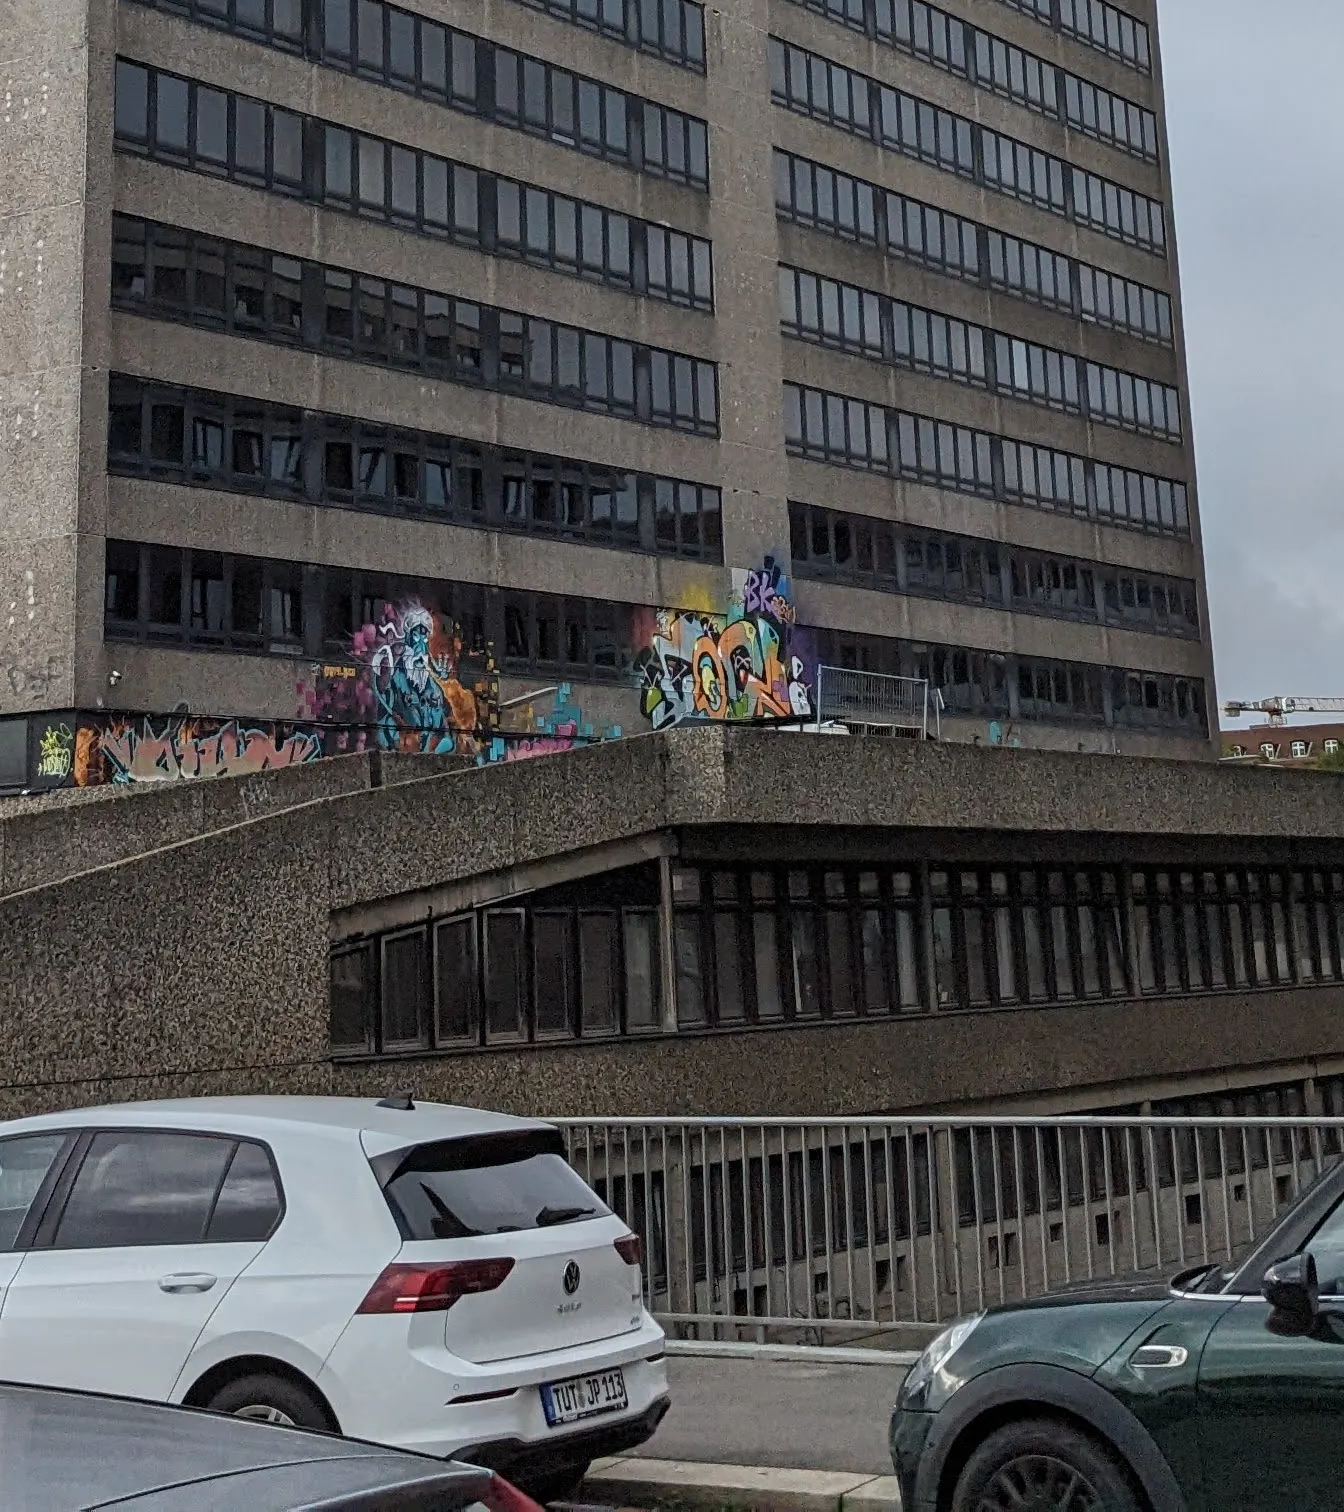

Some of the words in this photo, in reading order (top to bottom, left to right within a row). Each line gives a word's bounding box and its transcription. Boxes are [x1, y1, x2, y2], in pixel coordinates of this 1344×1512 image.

[553, 1384, 578, 1413] TUT
[586, 1378, 601, 1406] JP
[602, 1373, 624, 1402] 113
